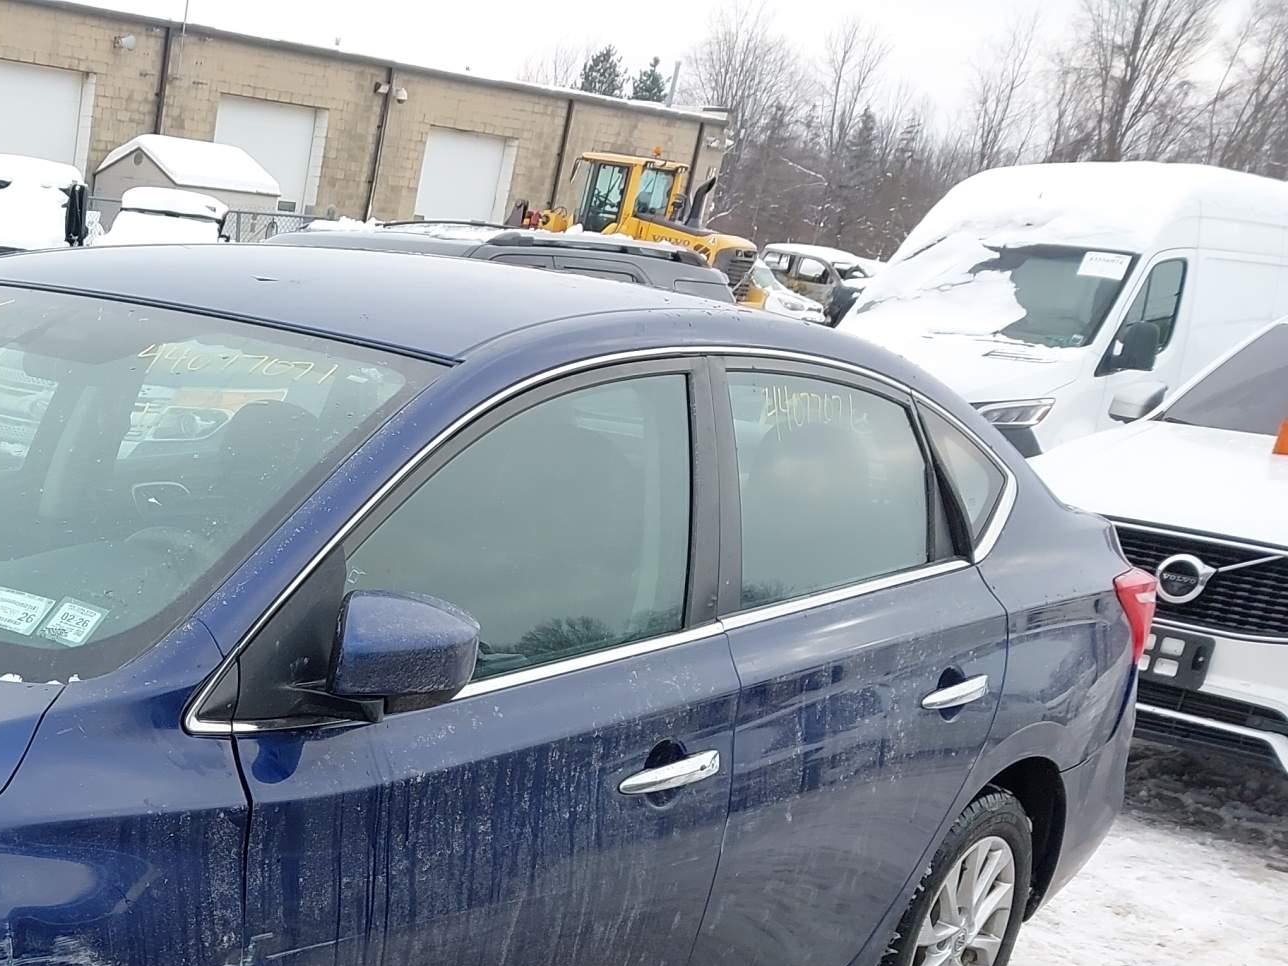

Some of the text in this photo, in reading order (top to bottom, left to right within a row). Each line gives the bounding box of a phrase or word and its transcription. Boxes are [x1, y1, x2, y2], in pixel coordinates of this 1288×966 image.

[137, 343, 339, 385] 44077071
[1162, 573, 1197, 584] VOLVO
[17, 612, 36, 624] 26
